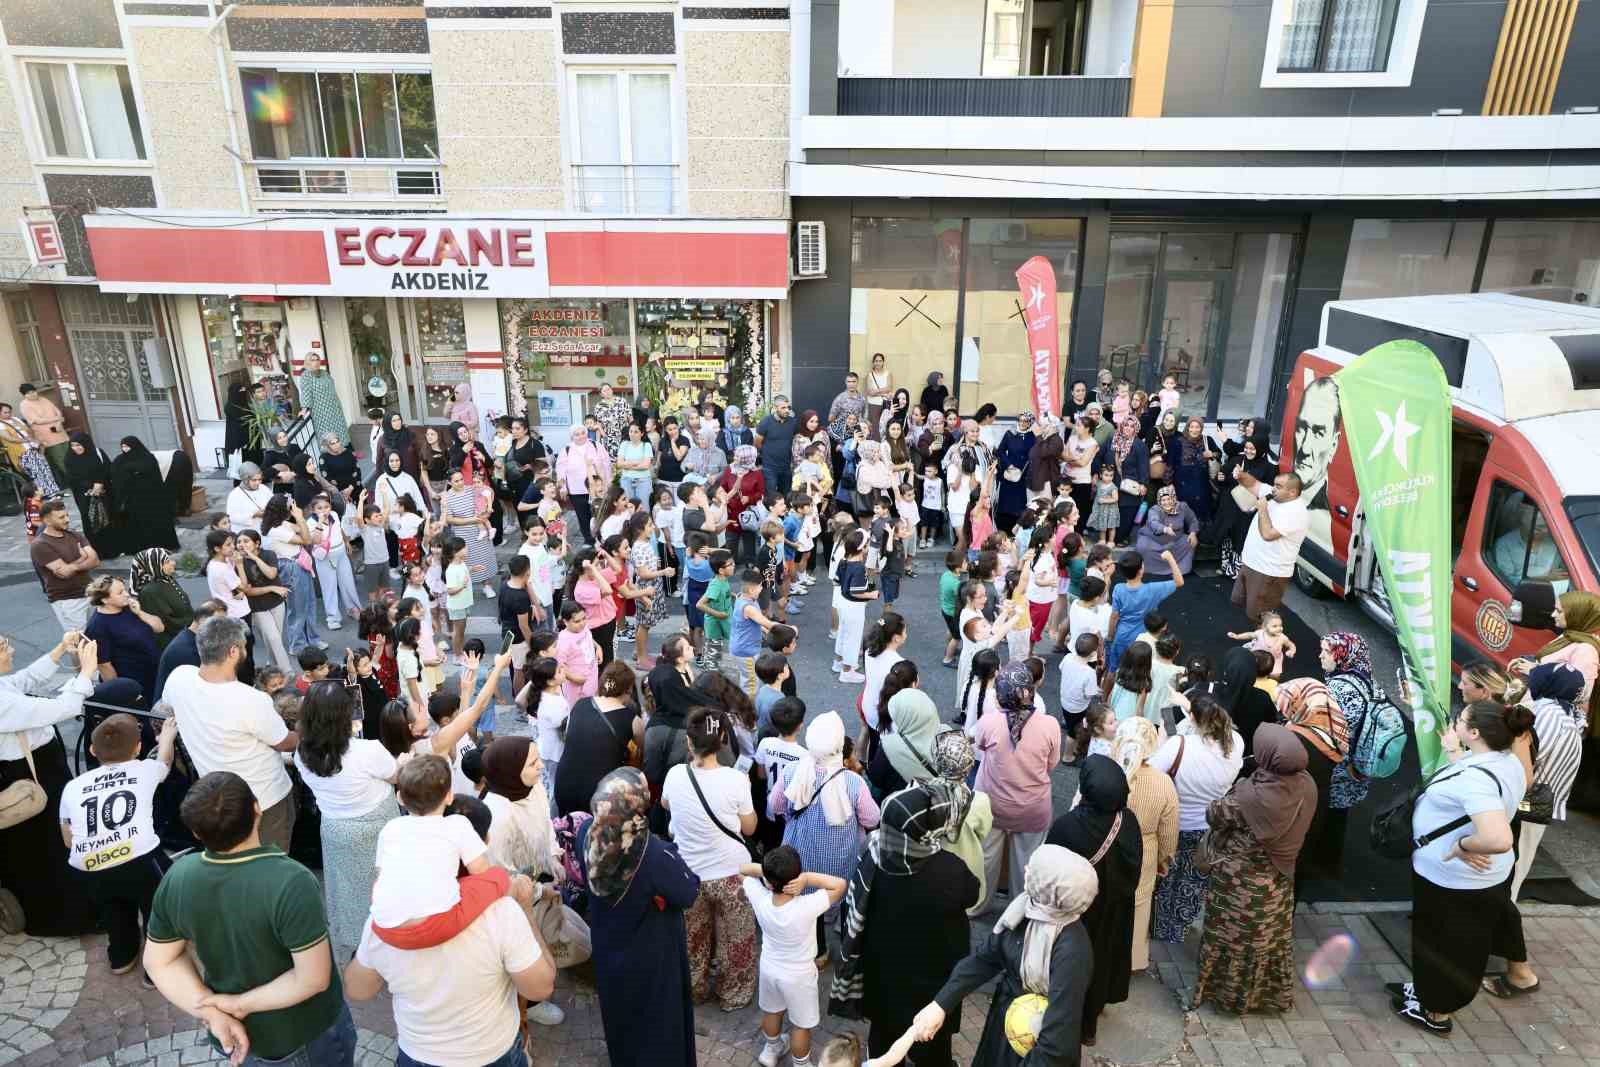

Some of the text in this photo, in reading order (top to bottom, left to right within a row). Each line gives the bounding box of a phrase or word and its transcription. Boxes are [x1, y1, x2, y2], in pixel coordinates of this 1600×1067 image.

[34, 227, 58, 256] E
[335, 227, 535, 267] ECZANE
[391, 268, 489, 290] AKDENİZ
[82, 777, 138, 794] SORTE
[94, 771, 127, 783] VIVA
[80, 790, 137, 838] 10
[75, 826, 139, 854] NEYMAR JR
[84, 846, 131, 870] placo
